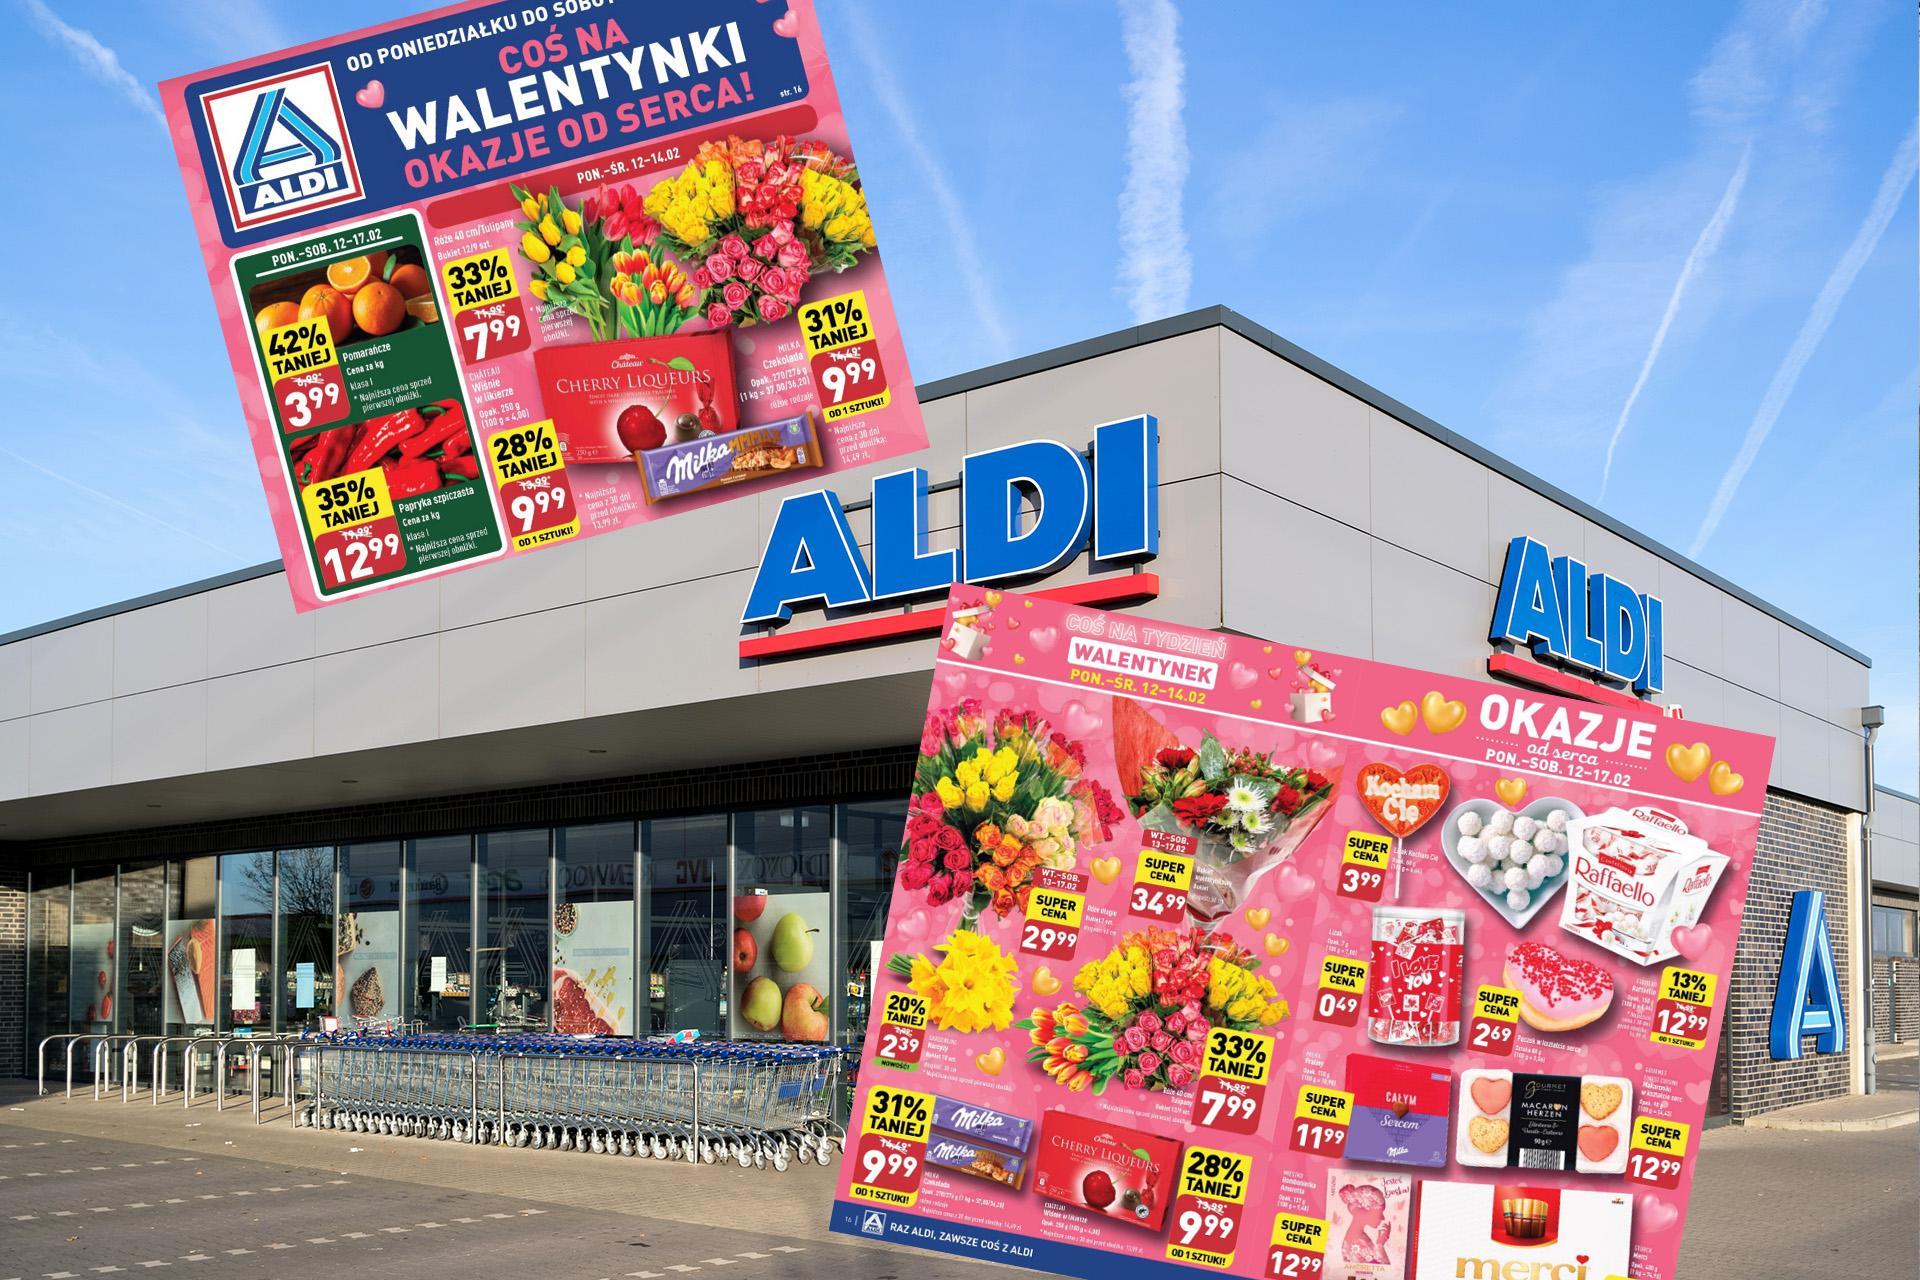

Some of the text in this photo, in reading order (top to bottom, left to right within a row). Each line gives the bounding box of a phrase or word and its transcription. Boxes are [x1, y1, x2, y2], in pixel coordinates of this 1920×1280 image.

[346, 51, 373, 72] OD
[376, 13, 517, 64] PONIEDZIAŁKU
[521, 5, 548, 26] DO
[498, 18, 630, 74] COŚ NA
[385, 20, 747, 151] WALENTYNKI
[779, 84, 802, 98] str. 16
[615, 71, 754, 133] SERCA!
[404, 111, 608, 188] OKAZJE OD
[630, 146, 681, 169] 12-14.02
[253, 166, 338, 209] ALDI
[332, 227, 383, 250] 12-17.02
[447, 255, 508, 290] 33%
[452, 279, 512, 307] TANIEJ
[804, 298, 863, 333] 31%
[268, 322, 327, 356] 42%
[808, 322, 868, 350] TANIEJ
[272, 347, 331, 375] TANIEJ
[341, 342, 391, 363] Pomarańcze
[345, 359, 385, 376] Cena za kg
[555, 376, 620, 394] CHERRY
[828, 408, 842, 418] OD
[848, 396, 884, 413] SZTUKI!
[493, 426, 553, 462] 28%
[498, 451, 557, 479] TANIEJ
[666, 442, 731, 484] Milka
[315, 476, 375, 511] 35%
[398, 485, 474, 513] Papryka szpiczasta
[320, 500, 379, 528] TANIEJ
[401, 510, 441, 527] Cena za kg
[740, 413, 1159, 626] ALDI
[518, 537, 531, 547] OD
[538, 525, 574, 542] SZTUKI!
[1488, 535, 1664, 695] ALDI
[1074, 642, 1213, 684] WALENTYNEK
[1142, 681, 1206, 705] 12-14.02
[1479, 693, 1657, 760] OKAZJE
[1567, 763, 1631, 787] 12-17.02
[1347, 836, 1388, 854] SUPER
[1352, 849, 1379, 863] CENA
[1144, 857, 1185, 874] SUPER
[1149, 870, 1176, 883] CENA
[1575, 857, 1654, 906] Raffaello
[1035, 894, 1076, 911] SUPER
[1040, 907, 1067, 920] CENA
[1323, 961, 1365, 979] SUPER
[1329, 974, 1355, 988] CENA
[1672, 970, 1707, 992] 13%
[887, 994, 926, 1015] 20%
[1478, 990, 1519, 1008] SUPER
[1667, 987, 1706, 1003] TANIEJ
[886, 1010, 924, 1026] TANIEJ
[1483, 1003, 1510, 1017] CENA
[1210, 1032, 1266, 1064] 33%
[1208, 1056, 1263, 1080] TANIEJ
[872, 1090, 927, 1122] 31%
[1304, 1091, 1346, 1109] SUPER
[1310, 1104, 1337, 1118] CENA
[869, 1114, 925, 1138] TANIEJ
[951, 1107, 1004, 1130] Milka
[1640, 1123, 1681, 1140] SUPER
[1645, 1136, 1672, 1149] CENA
[933, 1142, 977, 1160] Milka
[1187, 1151, 1244, 1183] 28%
[854, 1186, 868, 1196] OD
[874, 1190, 910, 1204] SZTUKI!
[1185, 1175, 1241, 1199] TANIEJ
[889, 1221, 1034, 1257] RAZ ALDI, ZAWSZE COŚ Z ALDI
[1280, 1219, 1322, 1237] SUPER
[1285, 1232, 1312, 1245] CENA
[1170, 1247, 1184, 1258] OD
[1190, 1251, 1226, 1266] SZTUKI!
